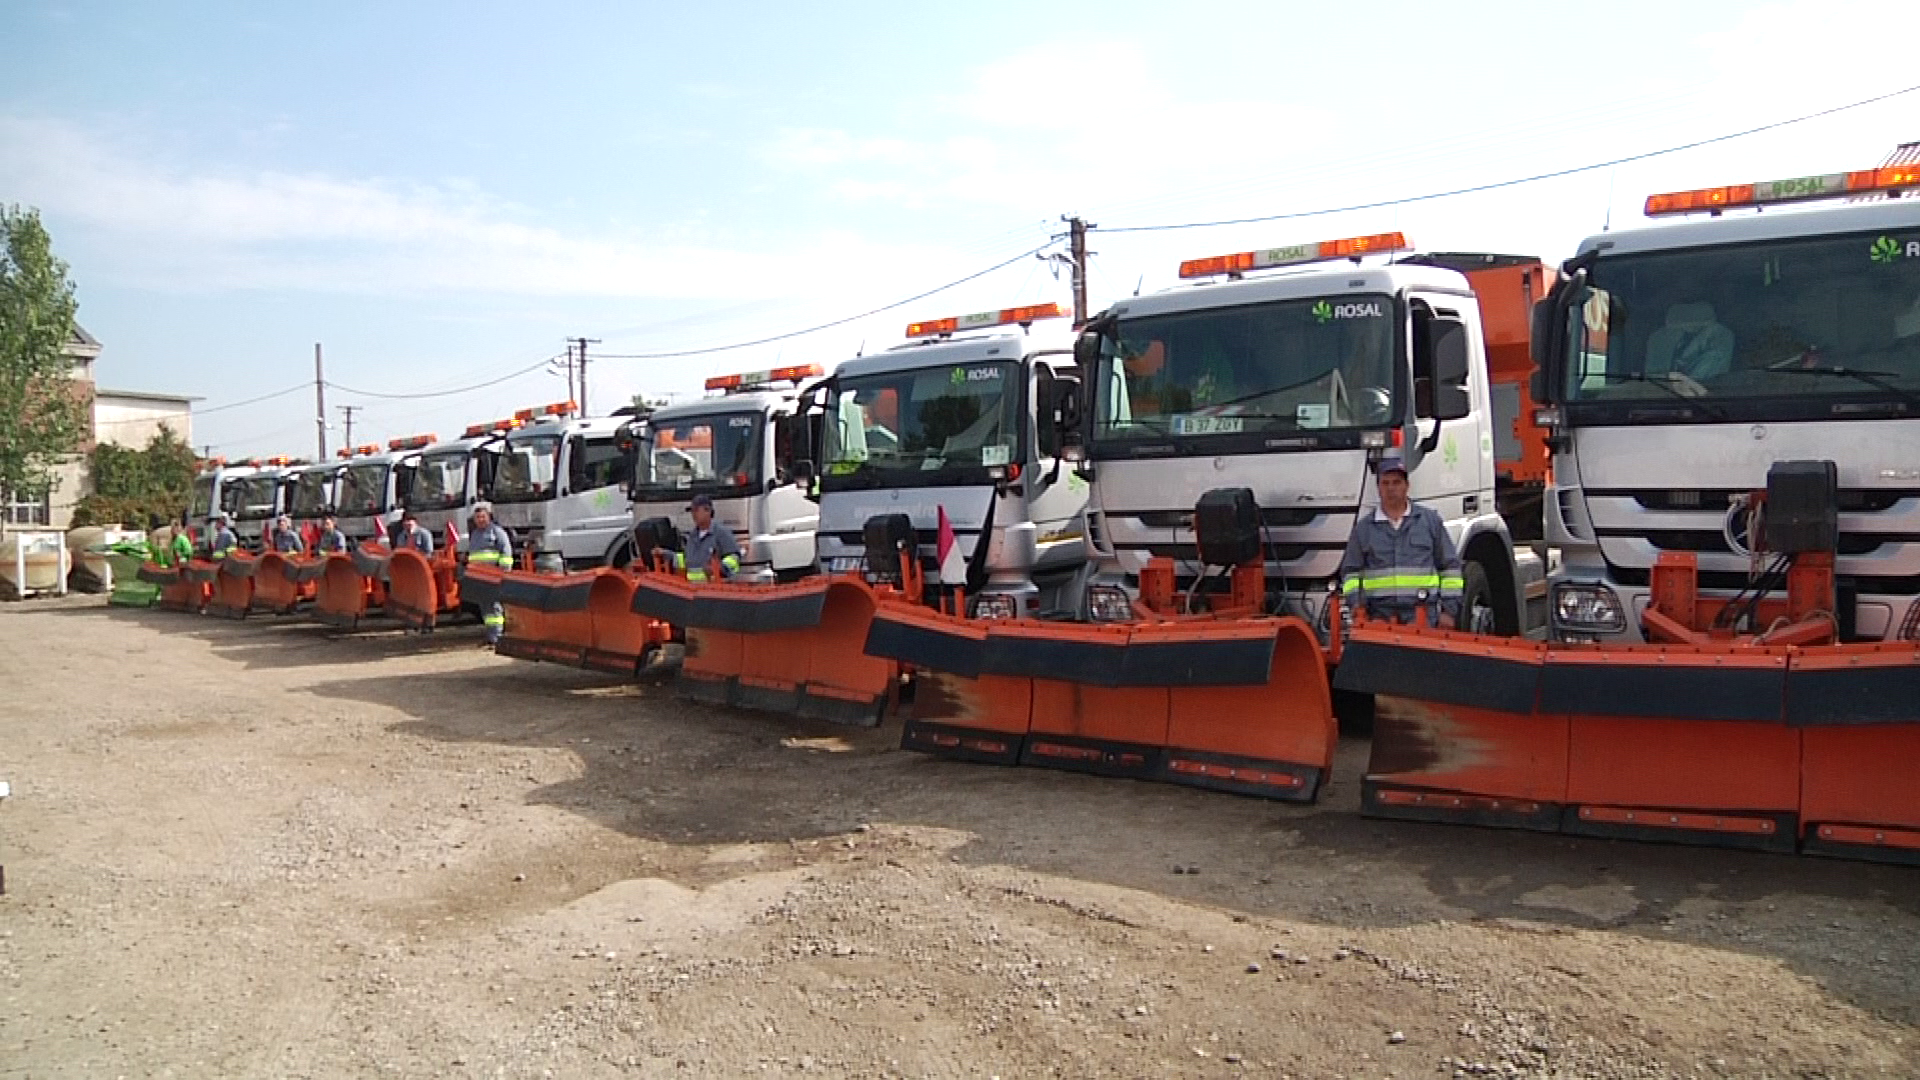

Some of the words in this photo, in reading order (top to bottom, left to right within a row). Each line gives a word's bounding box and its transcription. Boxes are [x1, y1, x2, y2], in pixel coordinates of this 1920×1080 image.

[1771, 176, 1825, 196] ROSAL
[1268, 246, 1307, 261] ROSAL
[1334, 303, 1382, 318] ROSAL
[967, 367, 1000, 381] ROSAL
